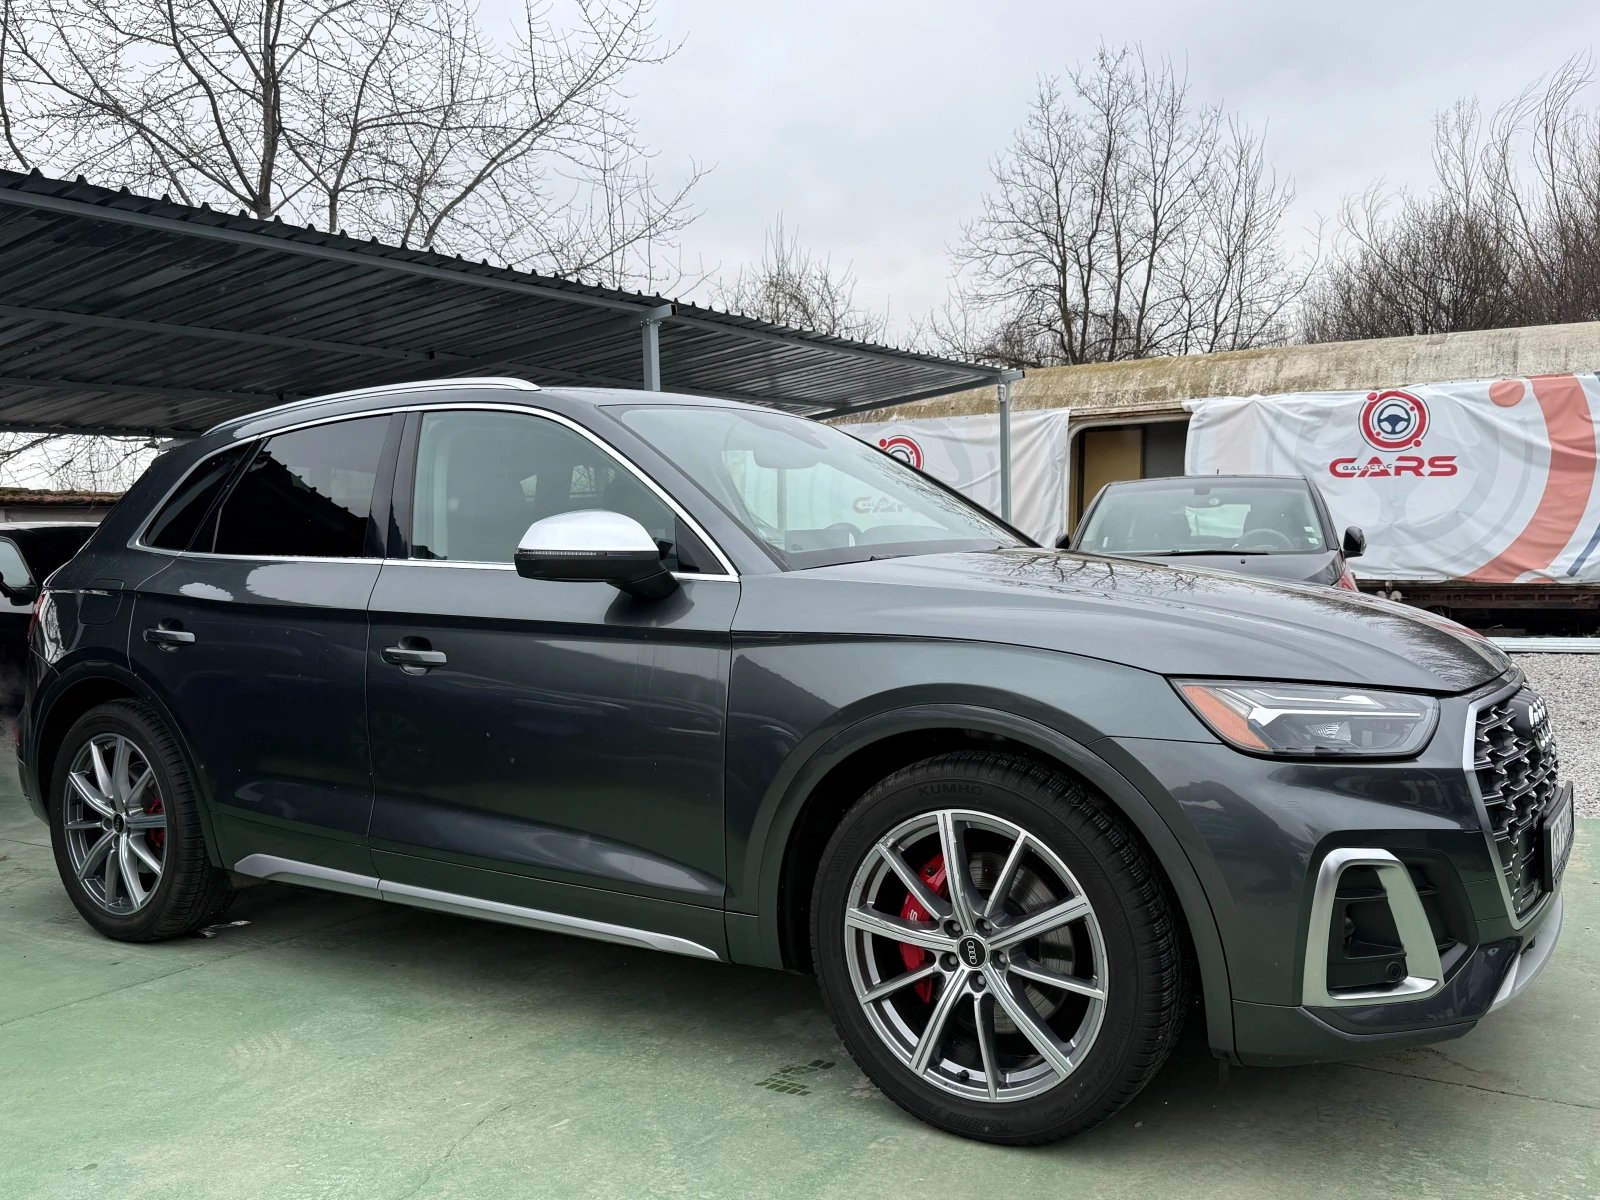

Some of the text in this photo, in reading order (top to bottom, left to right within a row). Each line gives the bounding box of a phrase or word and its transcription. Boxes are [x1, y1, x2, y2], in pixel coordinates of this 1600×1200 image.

[1329, 455, 1458, 478] CARS
[1342, 463, 1393, 471] GALACTIC
[918, 783, 983, 797] KUMHO
